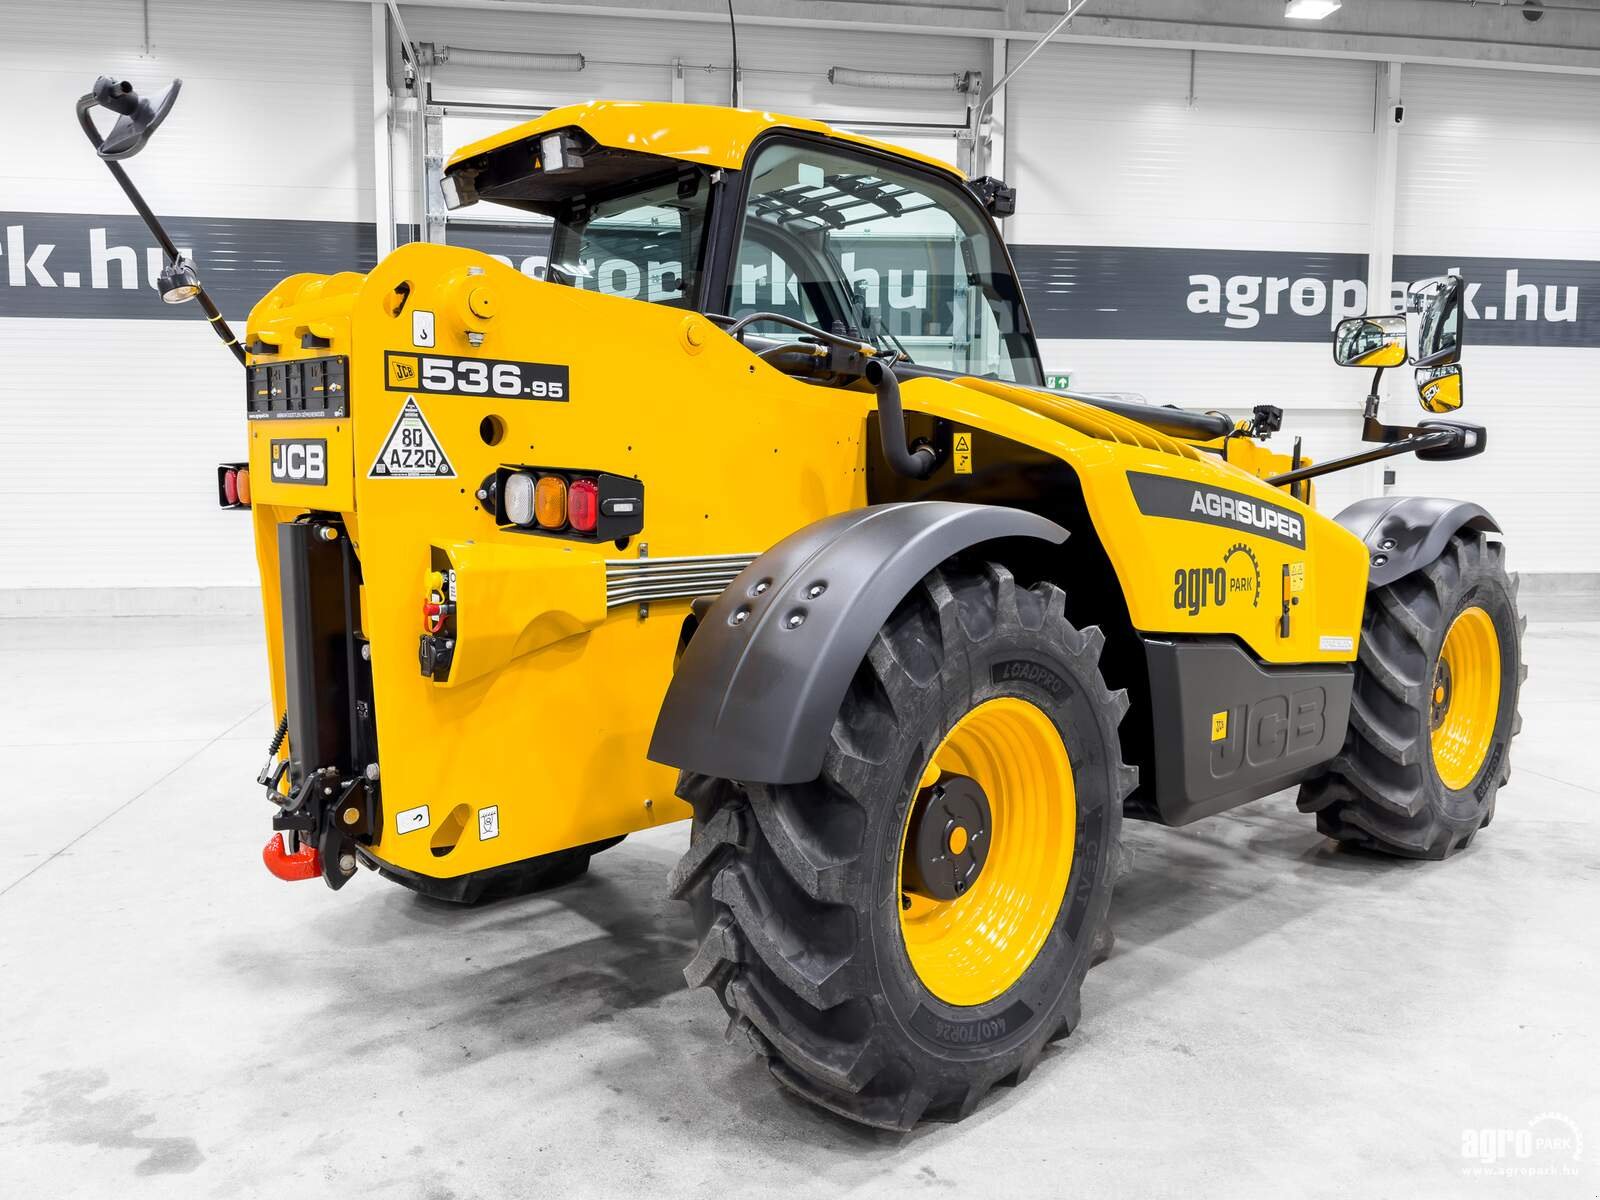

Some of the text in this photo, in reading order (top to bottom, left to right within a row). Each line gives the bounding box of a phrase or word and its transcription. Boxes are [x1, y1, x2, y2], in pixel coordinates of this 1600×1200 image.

[396, 363, 414, 379] JCB
[273, 444, 325, 479] JCB
[390, 449, 436, 468] AZ2Q
[1190, 490, 1302, 541] AGRISUPER
[1174, 567, 1253, 616] agro PARK
[1210, 686, 1326, 779] JCB
[1076, 840, 1099, 905] CEAT
